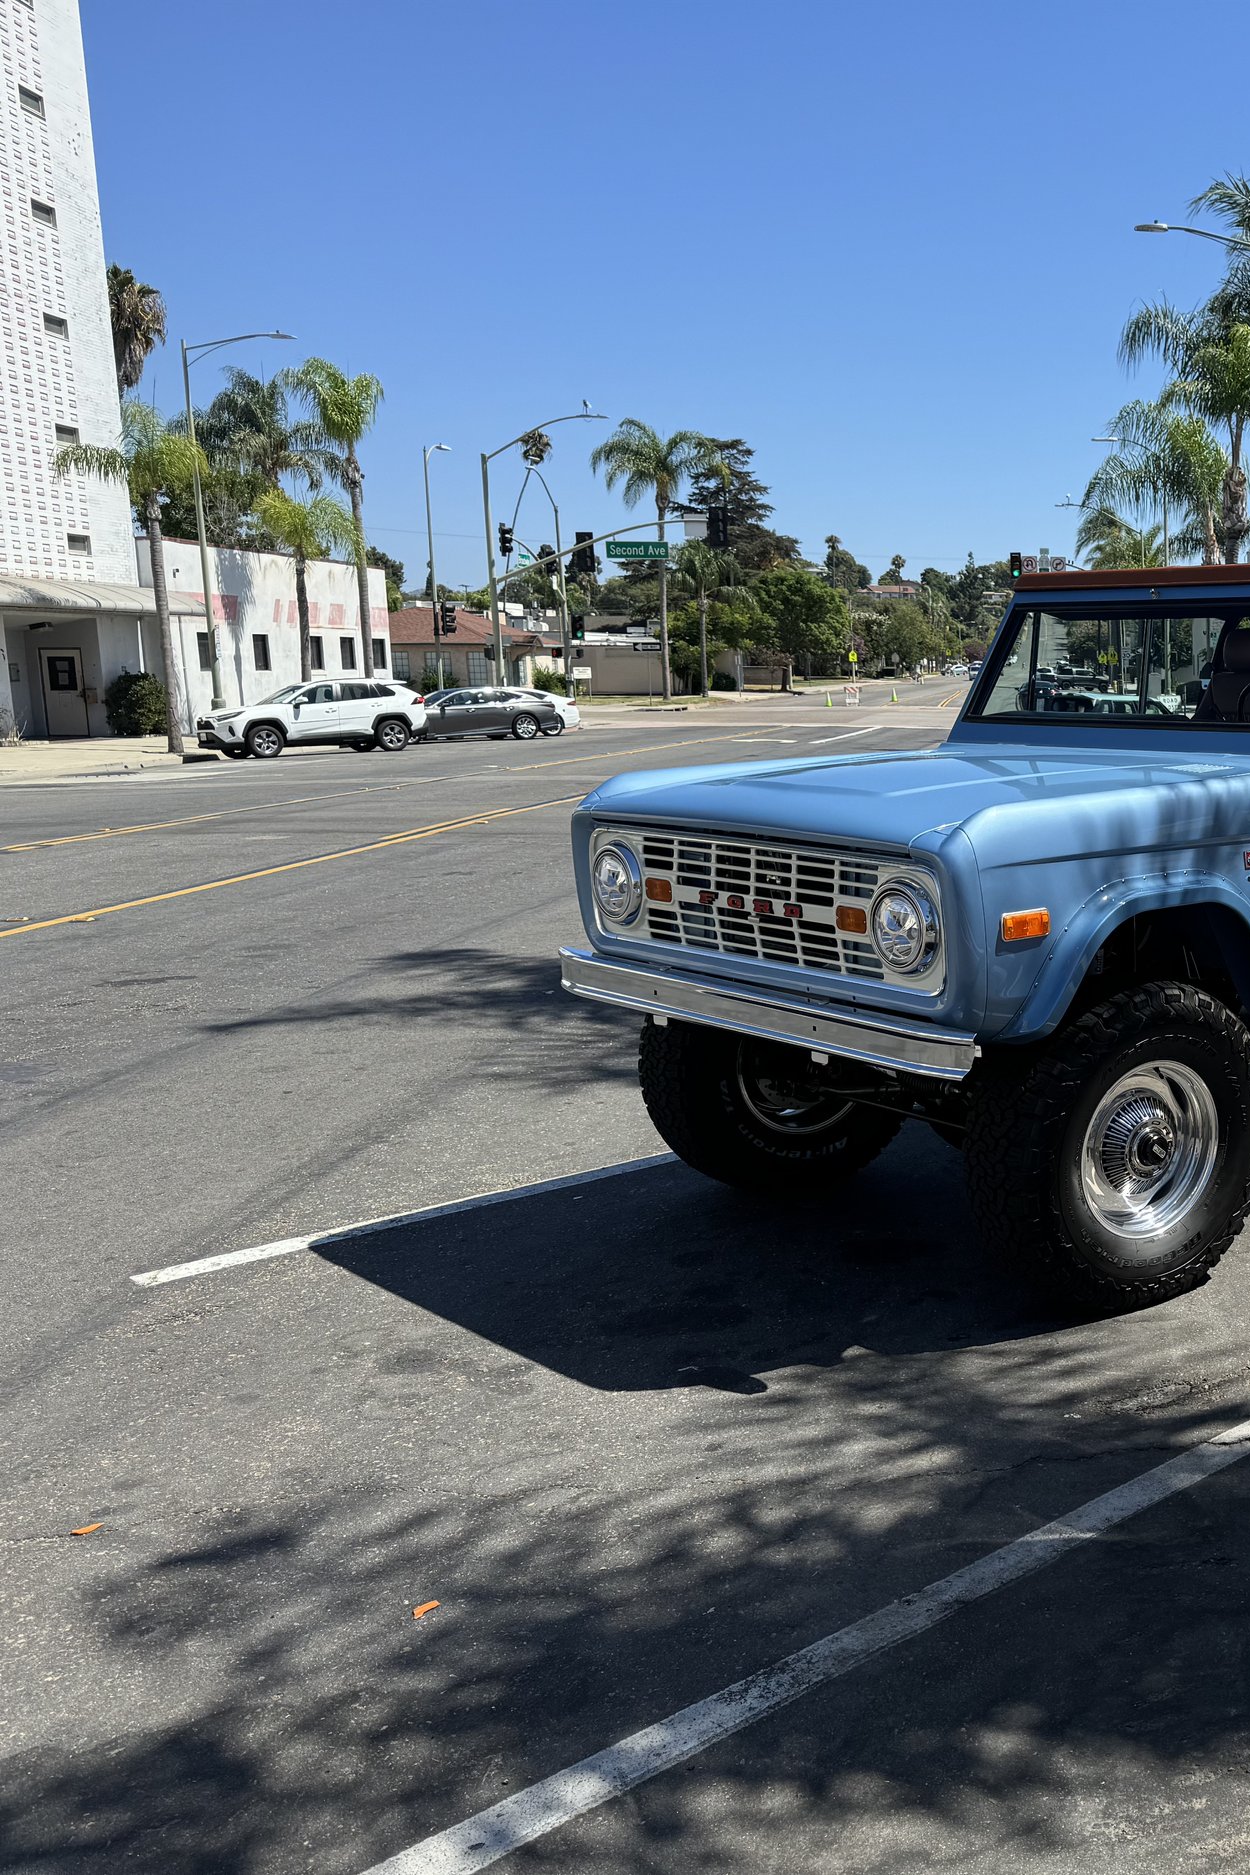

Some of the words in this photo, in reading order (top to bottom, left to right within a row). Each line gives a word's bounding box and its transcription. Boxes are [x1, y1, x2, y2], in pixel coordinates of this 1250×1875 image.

[609, 544, 645, 556] Second
[648, 544, 666, 556] Ave
[698, 889, 804, 919] FORD
